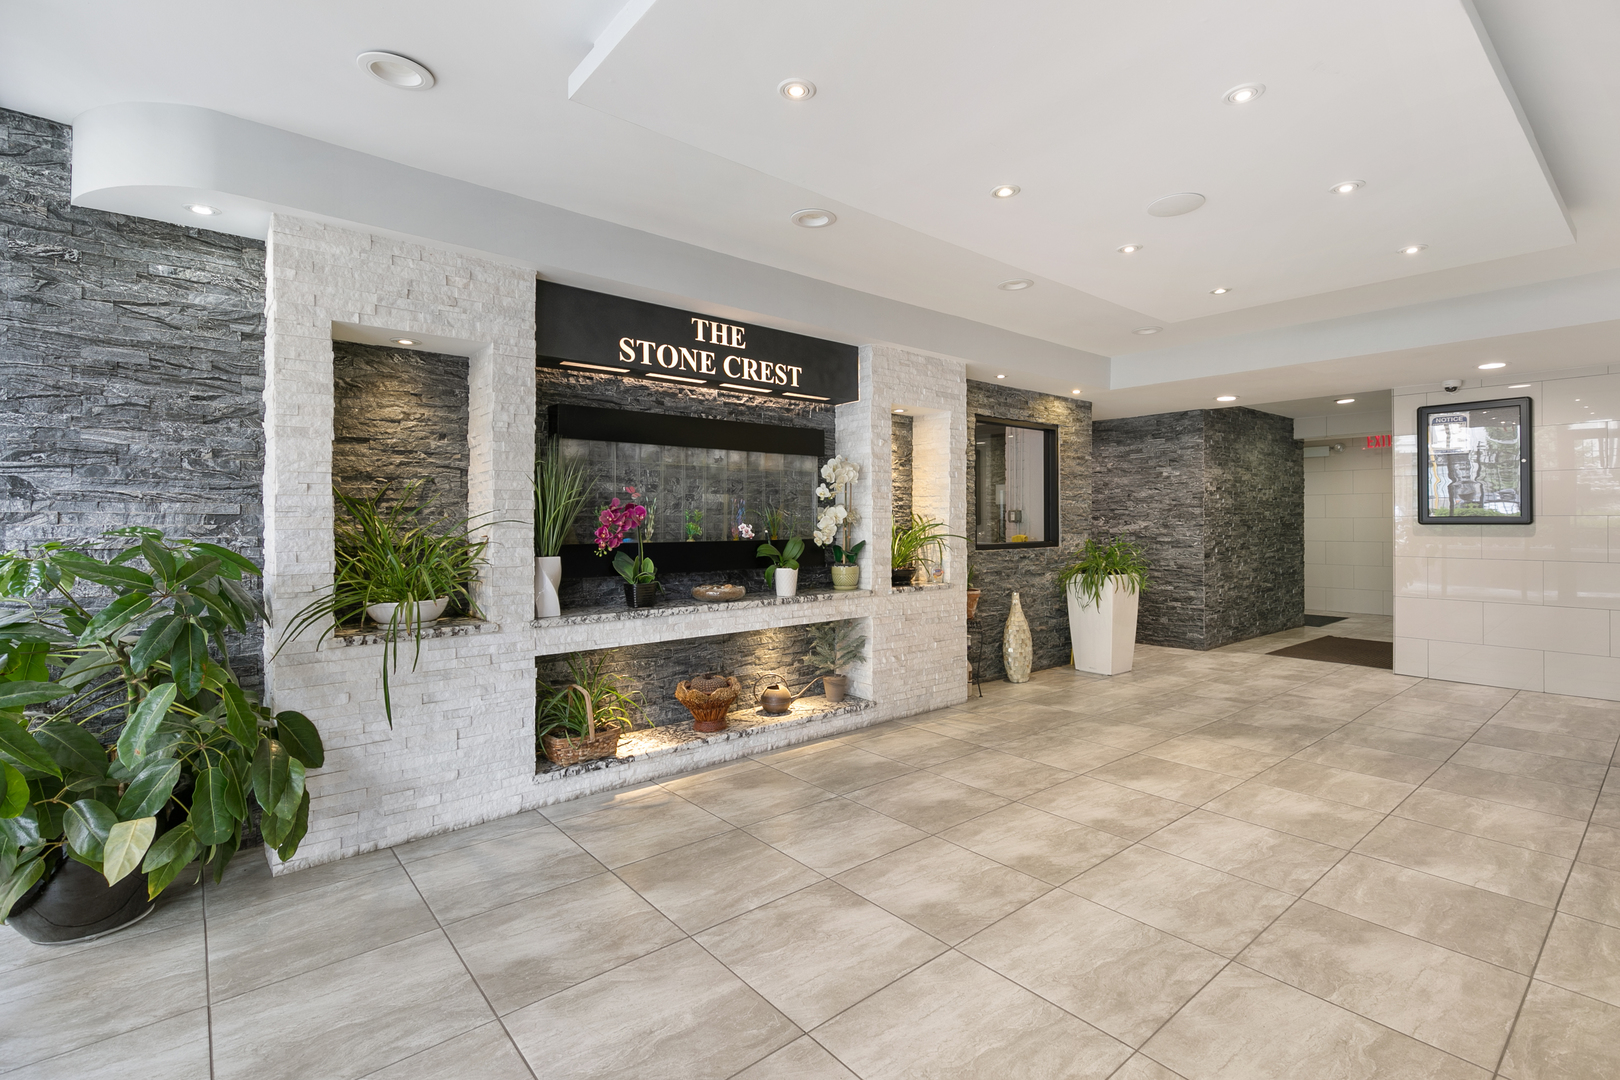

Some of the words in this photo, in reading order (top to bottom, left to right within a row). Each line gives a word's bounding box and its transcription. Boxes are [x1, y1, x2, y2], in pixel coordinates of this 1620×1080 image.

[691, 317, 746, 349] THE
[618, 337, 717, 375] STONE
[722, 355, 803, 388] CREST
